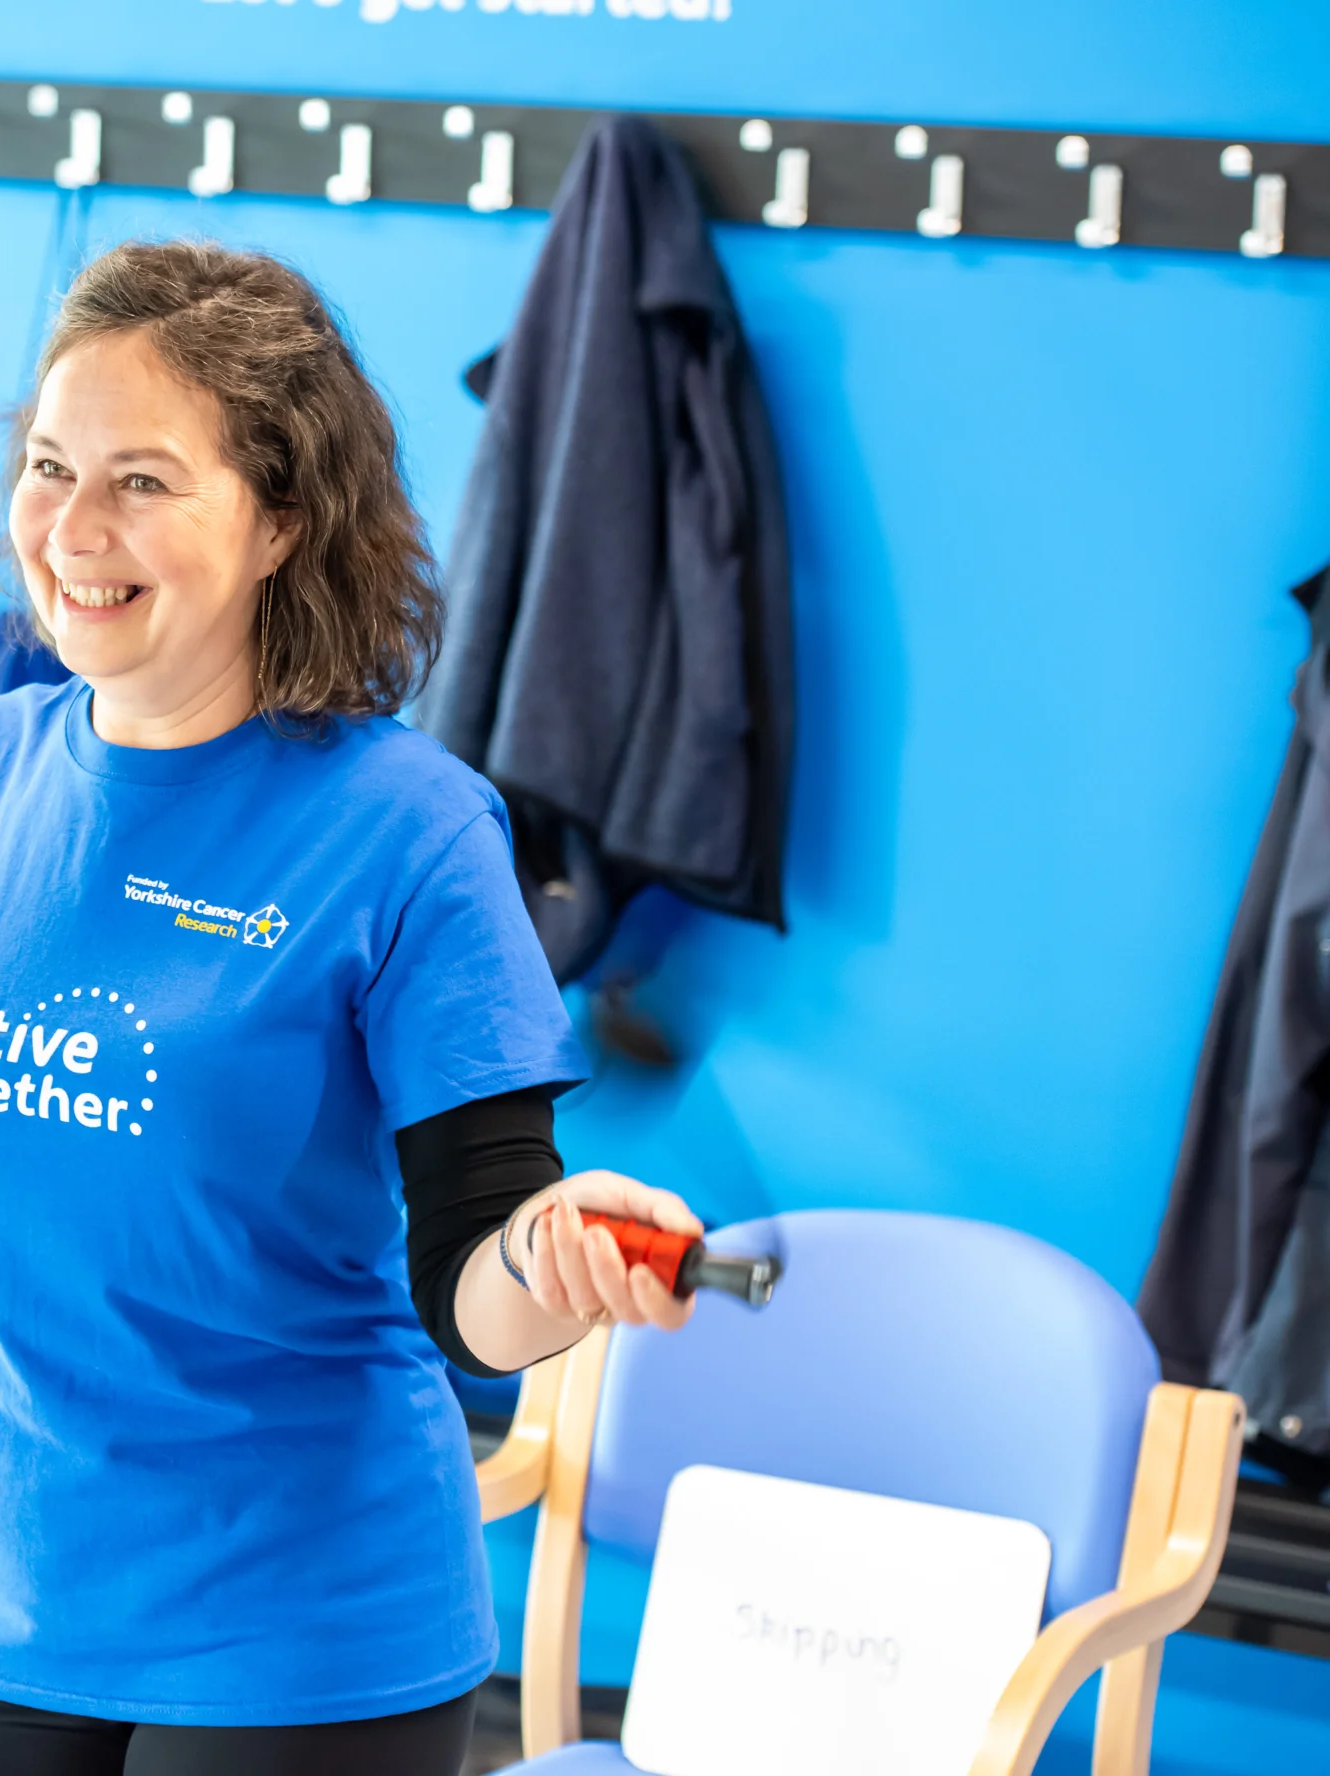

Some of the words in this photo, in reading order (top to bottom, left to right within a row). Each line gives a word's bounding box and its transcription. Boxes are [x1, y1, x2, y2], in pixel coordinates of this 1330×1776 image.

[127, 874, 158, 888] Funded
[158, 880, 169, 891] by
[124, 884, 192, 911] Yorkshire
[193, 900, 246, 922] Cancer
[174, 913, 238, 938] Research
[735, 1602, 901, 1685] Skipping
